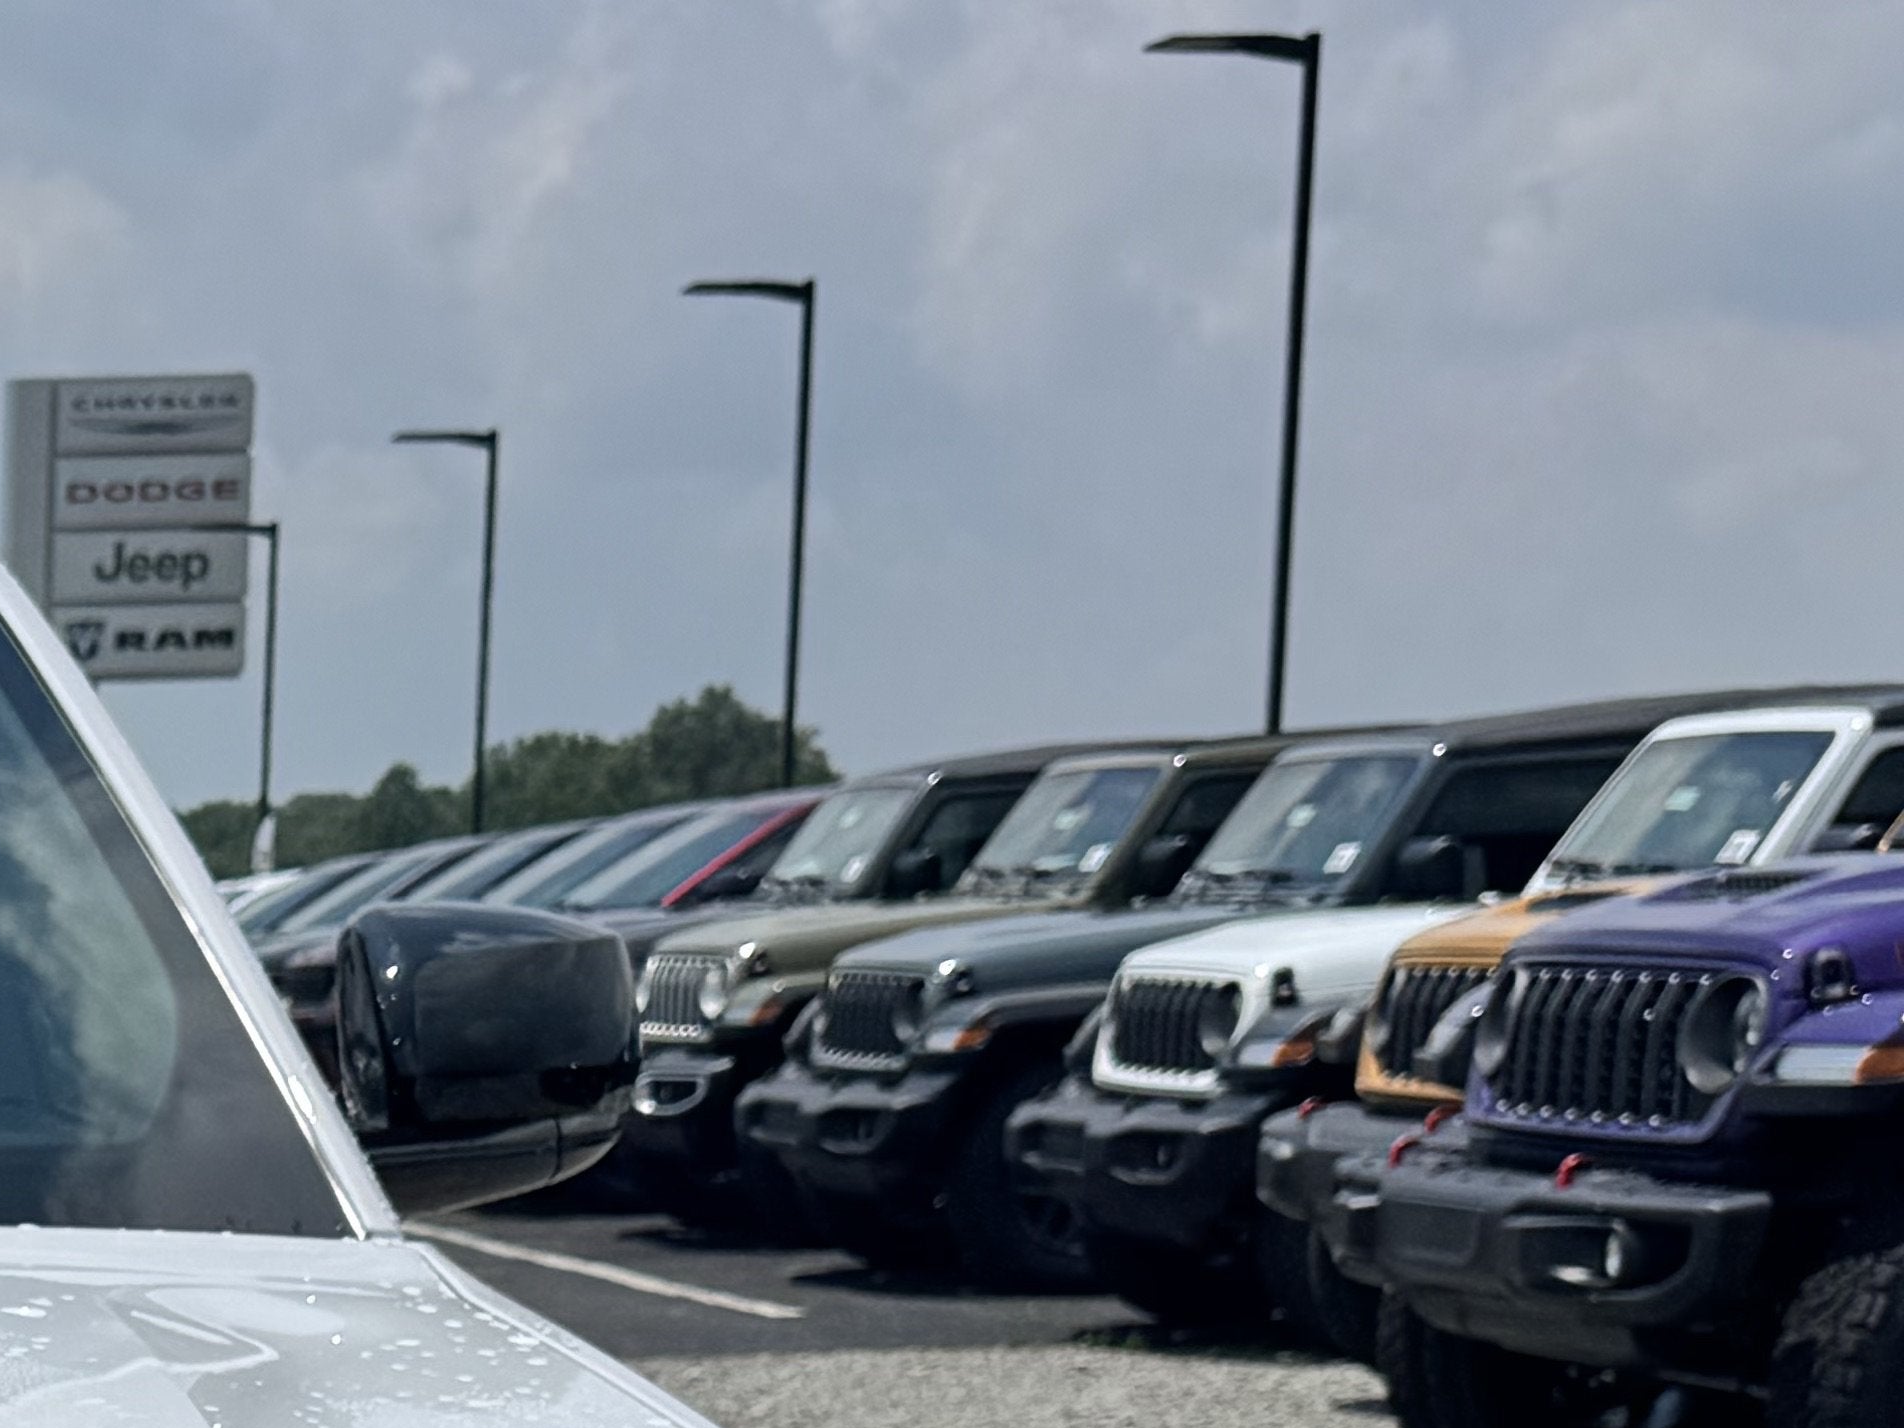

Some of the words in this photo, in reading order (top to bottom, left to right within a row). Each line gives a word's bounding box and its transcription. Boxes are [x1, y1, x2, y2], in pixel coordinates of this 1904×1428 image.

[67, 479, 240, 503] DODGE
[95, 541, 210, 592] Jeep
[115, 628, 235, 652] RAM
